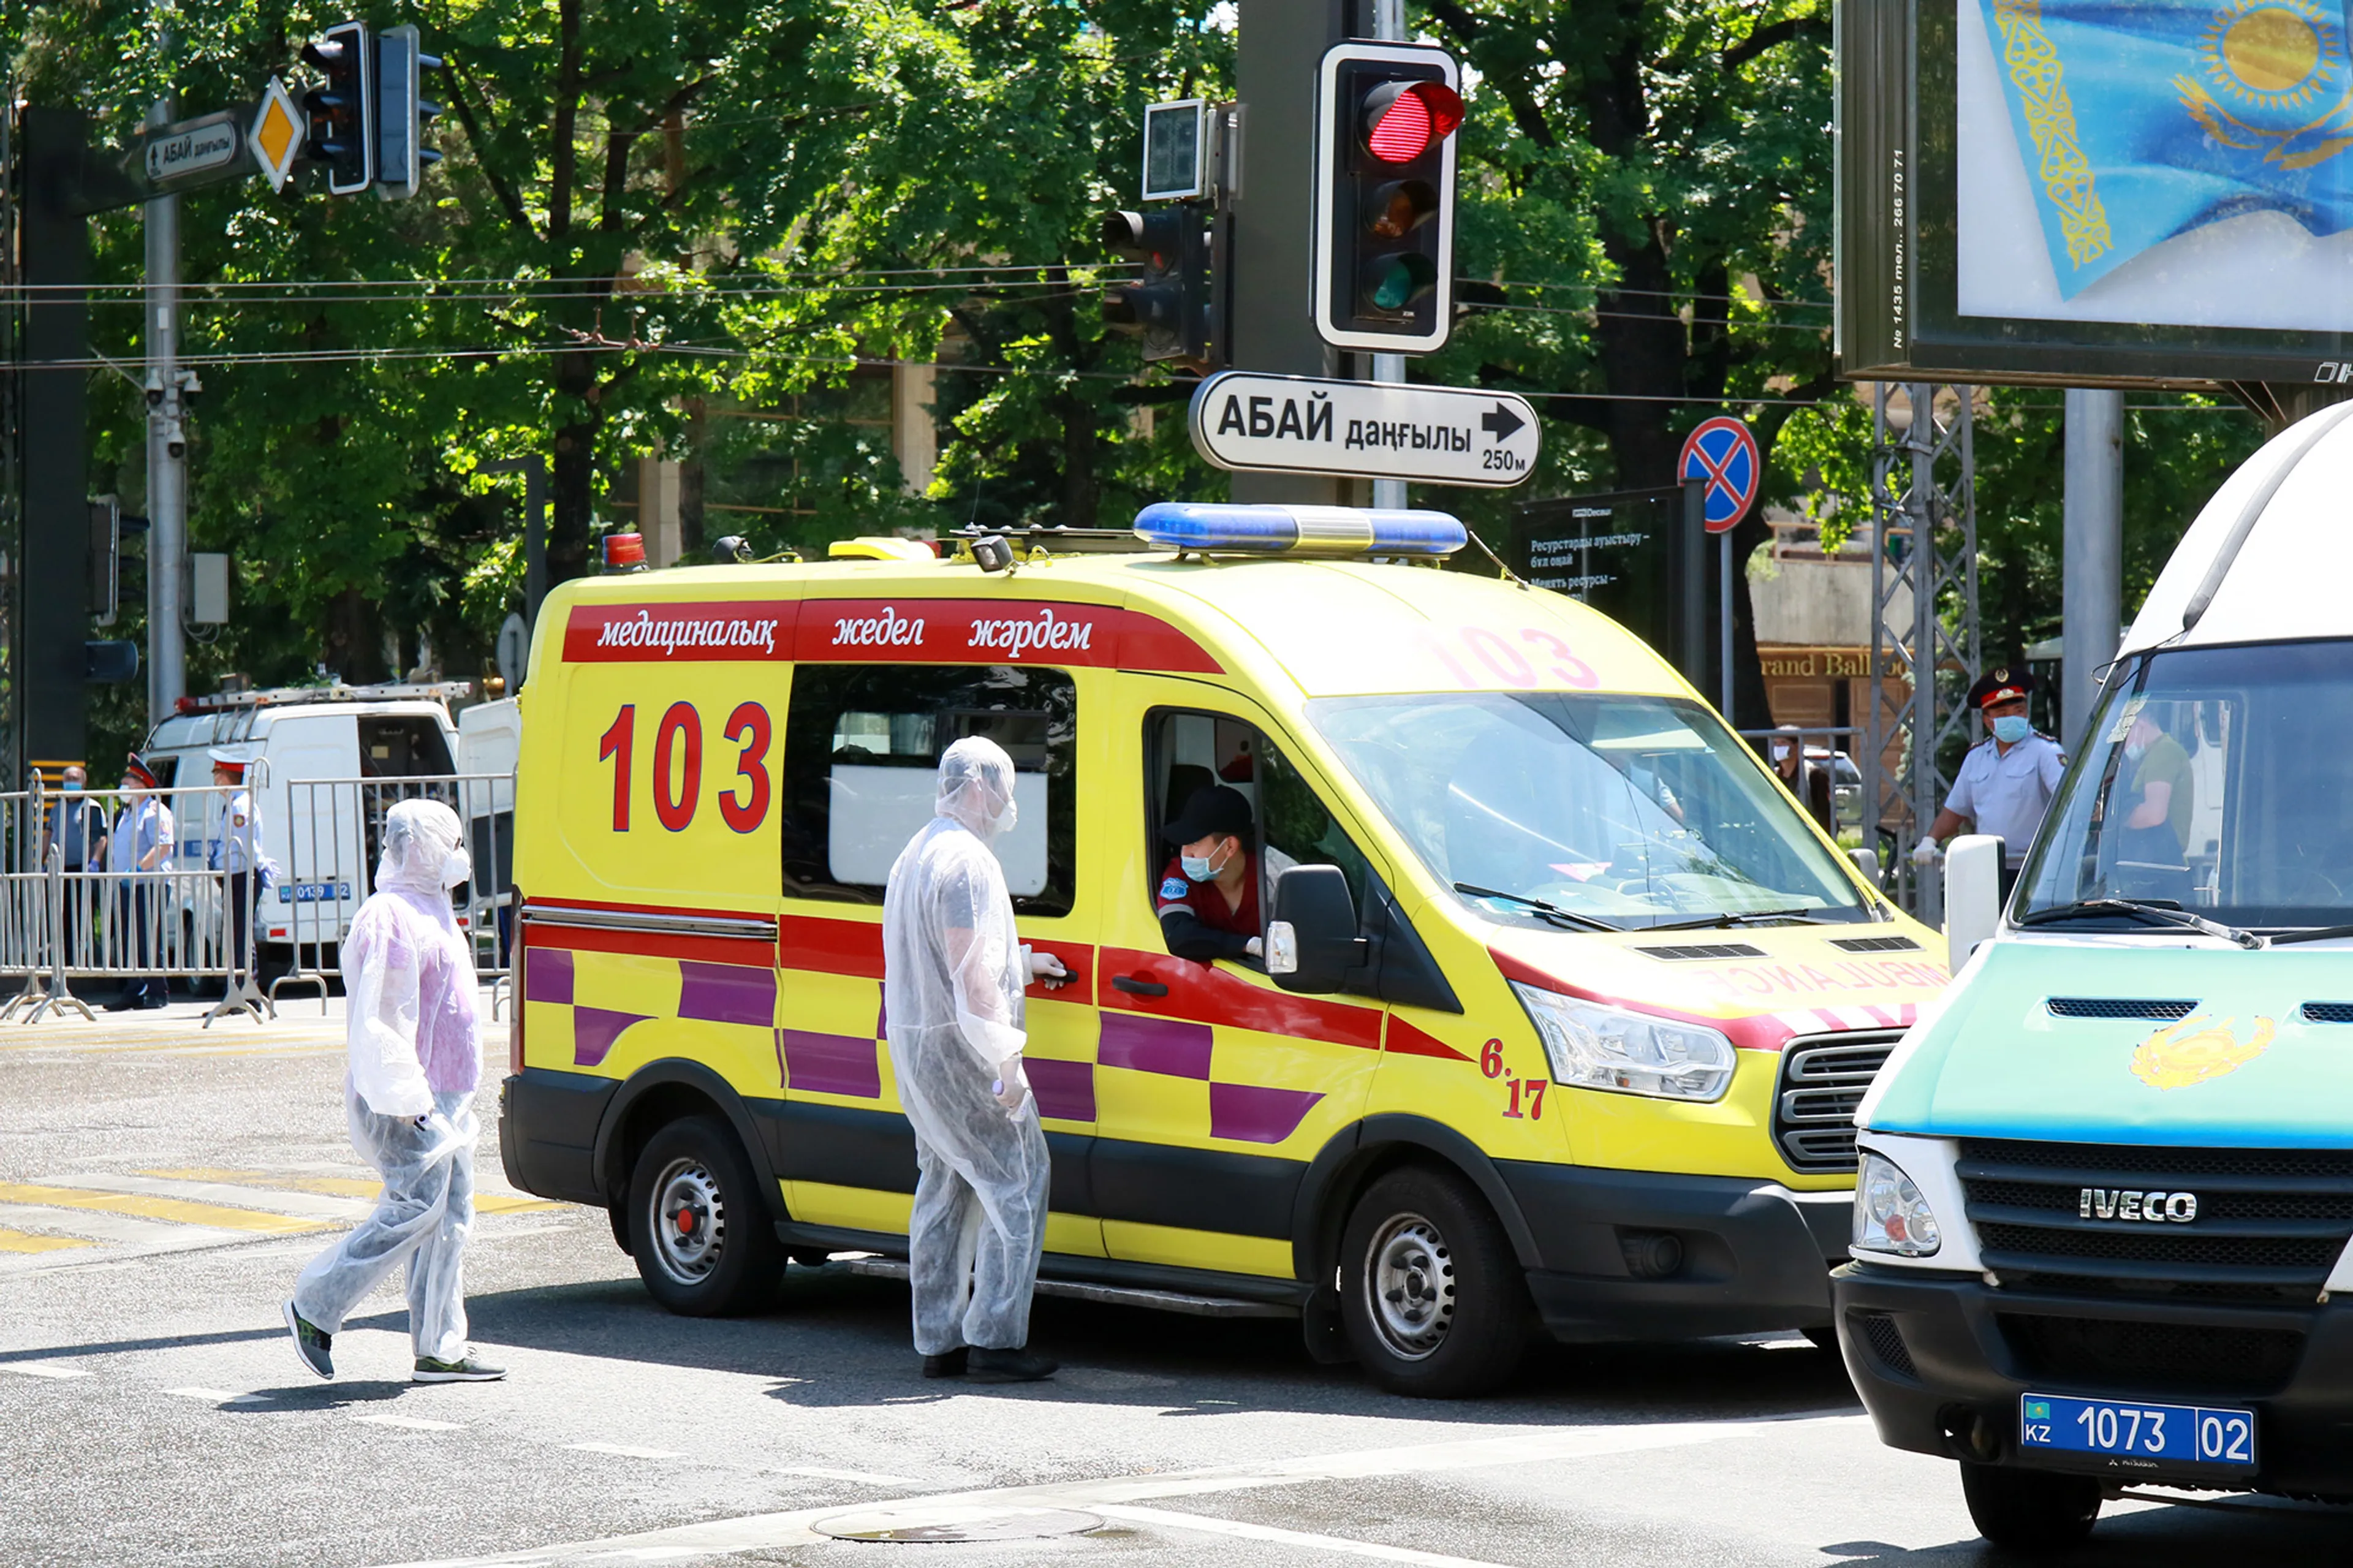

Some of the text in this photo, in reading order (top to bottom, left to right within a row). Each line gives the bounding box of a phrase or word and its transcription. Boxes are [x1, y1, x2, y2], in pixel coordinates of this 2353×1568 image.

[163, 135, 192, 165] АБАЙ
[1893, 149, 1903, 168] 71
[1893, 172, 1903, 193] 70
[1893, 197, 1903, 227] 266
[1893, 285, 1903, 325] 1435
[1893, 329, 1903, 350] №
[1217, 390, 1471, 453] АБАЙ даңғылы
[597, 606, 1093, 658] медициналық жедел жәрдем
[1414, 626, 1601, 690] 103
[1760, 653, 1816, 677] rand
[599, 700, 772, 834] 103
[1502, 1078, 1548, 1120] 17
[2079, 1187, 2197, 1223] IVECO
[2025, 1424, 2052, 1443] KZ
[2077, 1406, 2249, 1461] 1073 02
